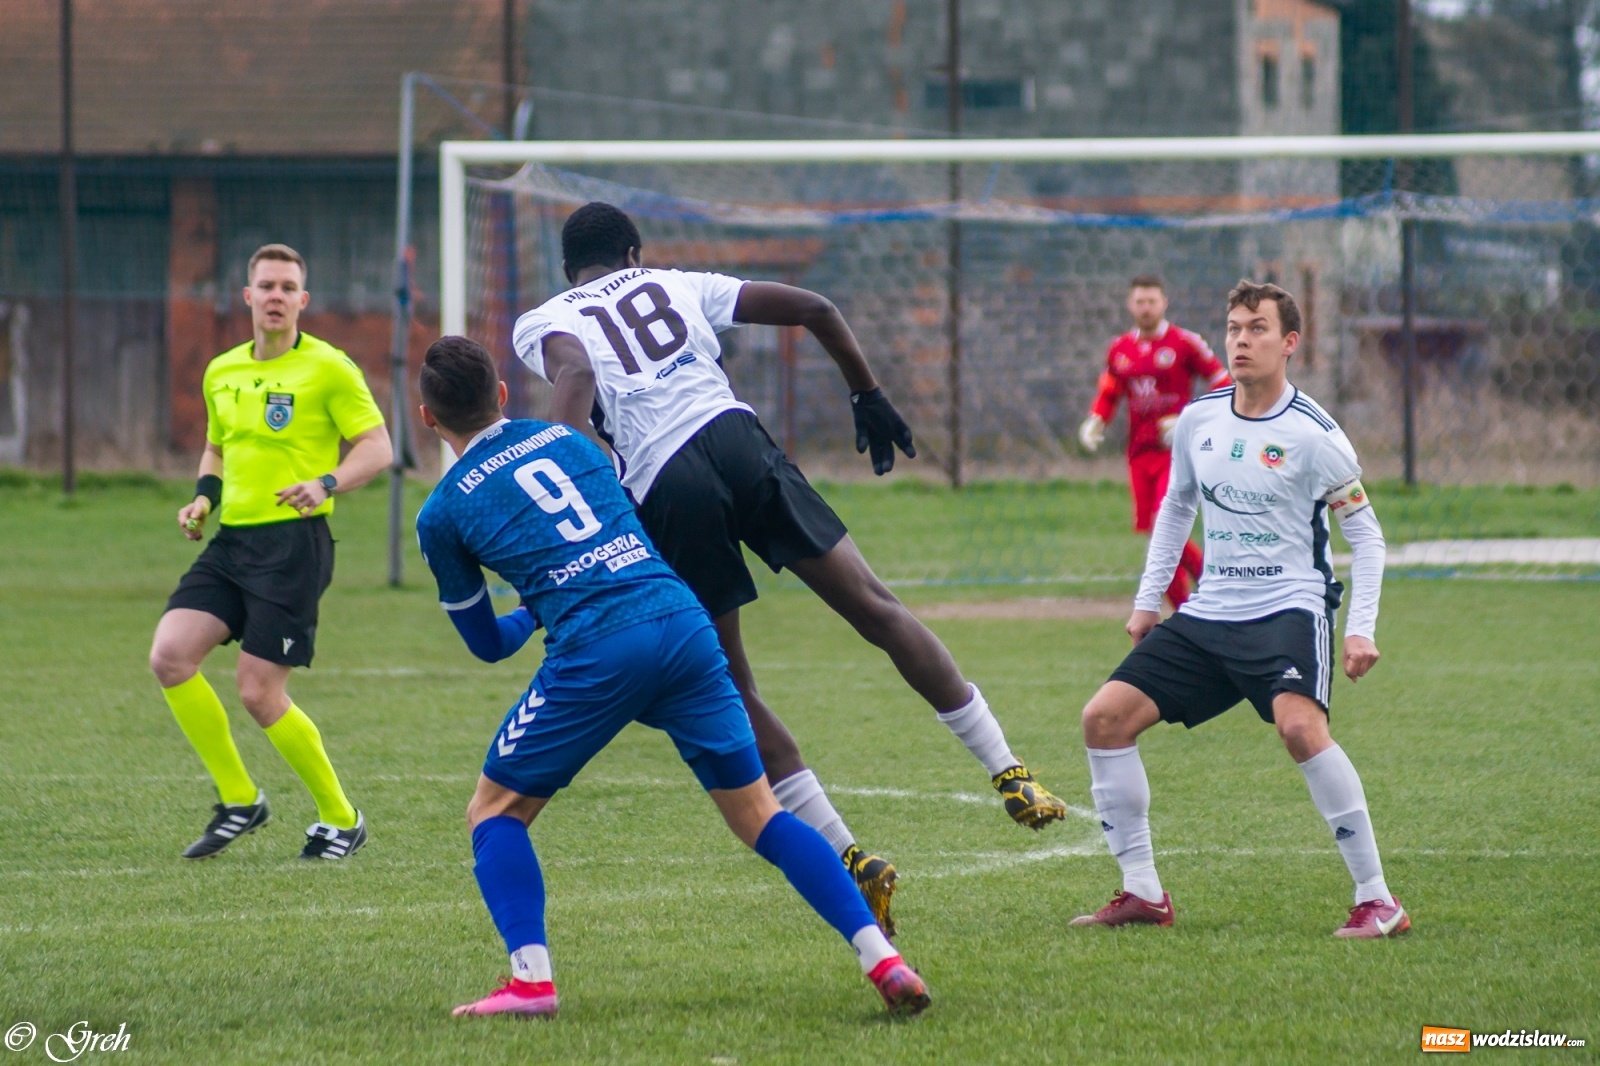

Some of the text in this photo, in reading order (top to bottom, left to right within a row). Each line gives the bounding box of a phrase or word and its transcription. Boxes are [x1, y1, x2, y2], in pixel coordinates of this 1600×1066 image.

[578, 281, 688, 376] 18
[457, 468, 486, 495] LKS
[513, 457, 603, 543] 9
[553, 533, 644, 586] DROGERIA
[1218, 565, 1283, 577] WENINGER
